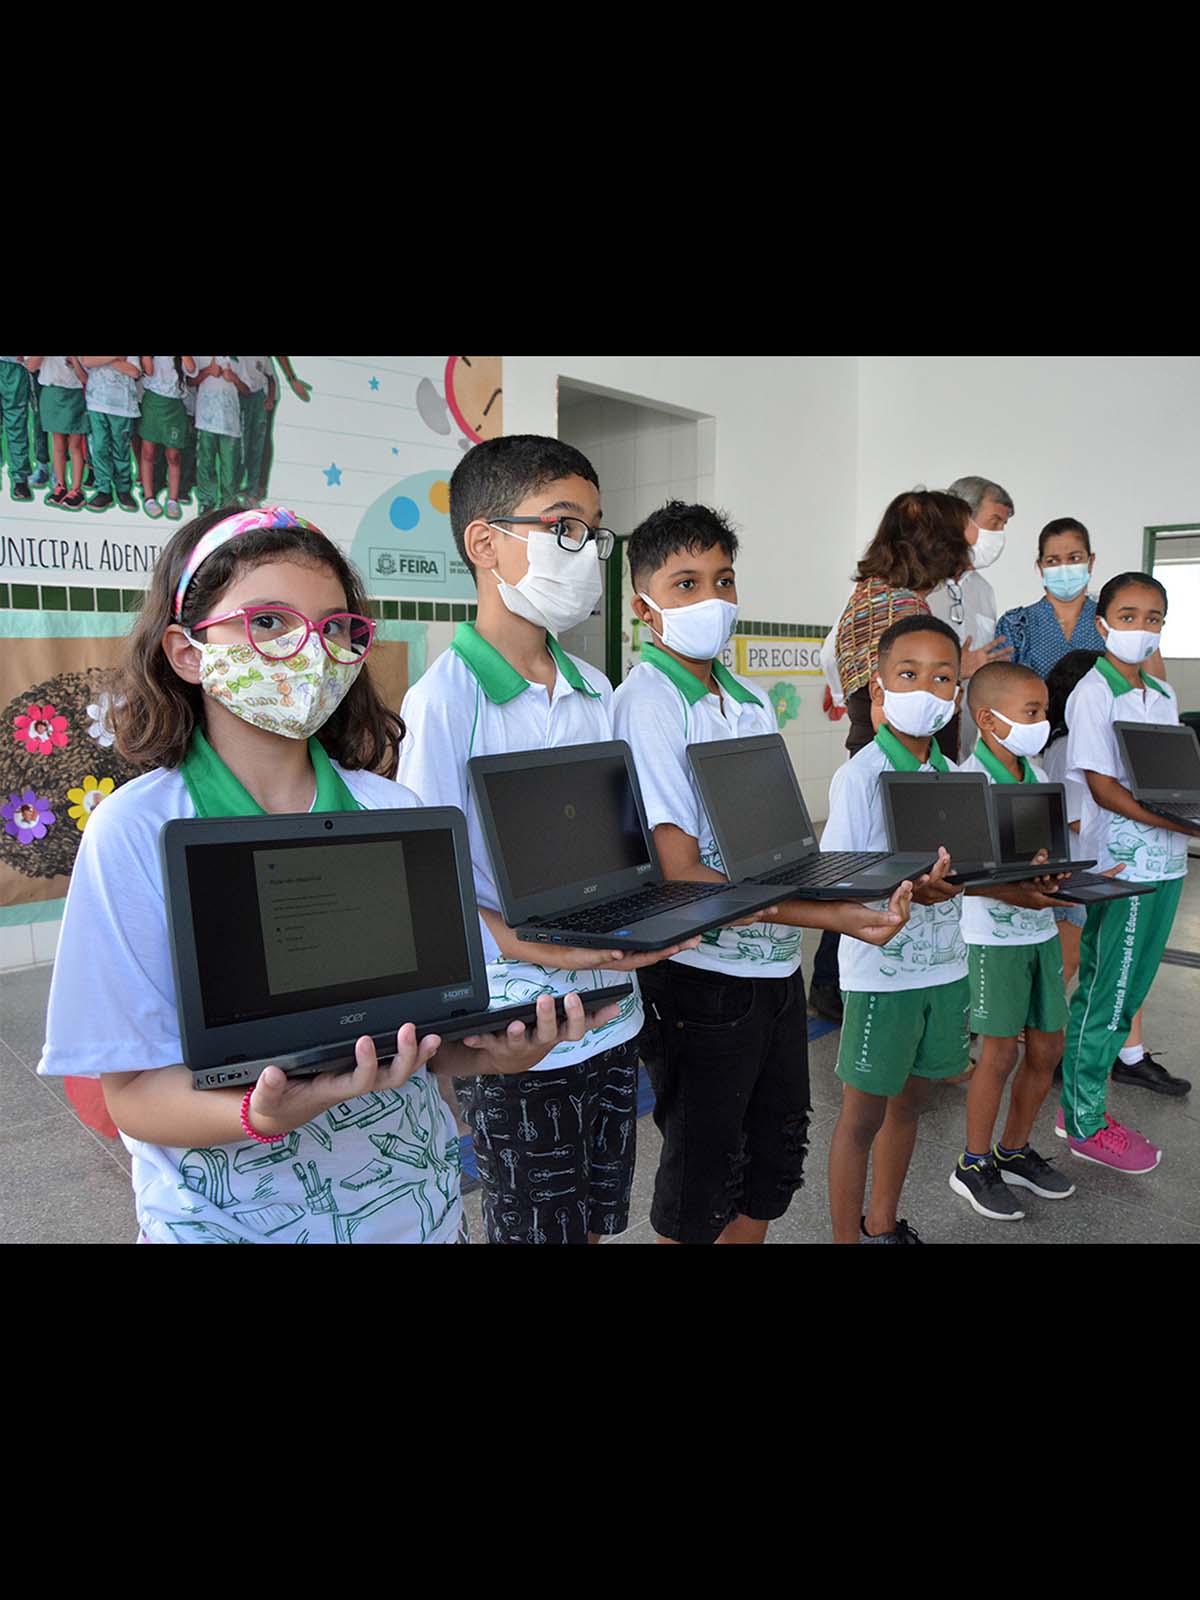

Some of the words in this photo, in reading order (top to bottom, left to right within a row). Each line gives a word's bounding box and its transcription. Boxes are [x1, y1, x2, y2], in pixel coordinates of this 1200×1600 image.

[400, 559, 438, 575] FEIRA
[1125, 895, 1140, 934] Educaçã
[1124, 934, 1135, 947] de
[1117, 946, 1133, 989] Municipal
[339, 1011, 367, 1025] acer
[1107, 988, 1126, 1031] Secretaria
[861, 1013, 873, 1063] SANTANA
